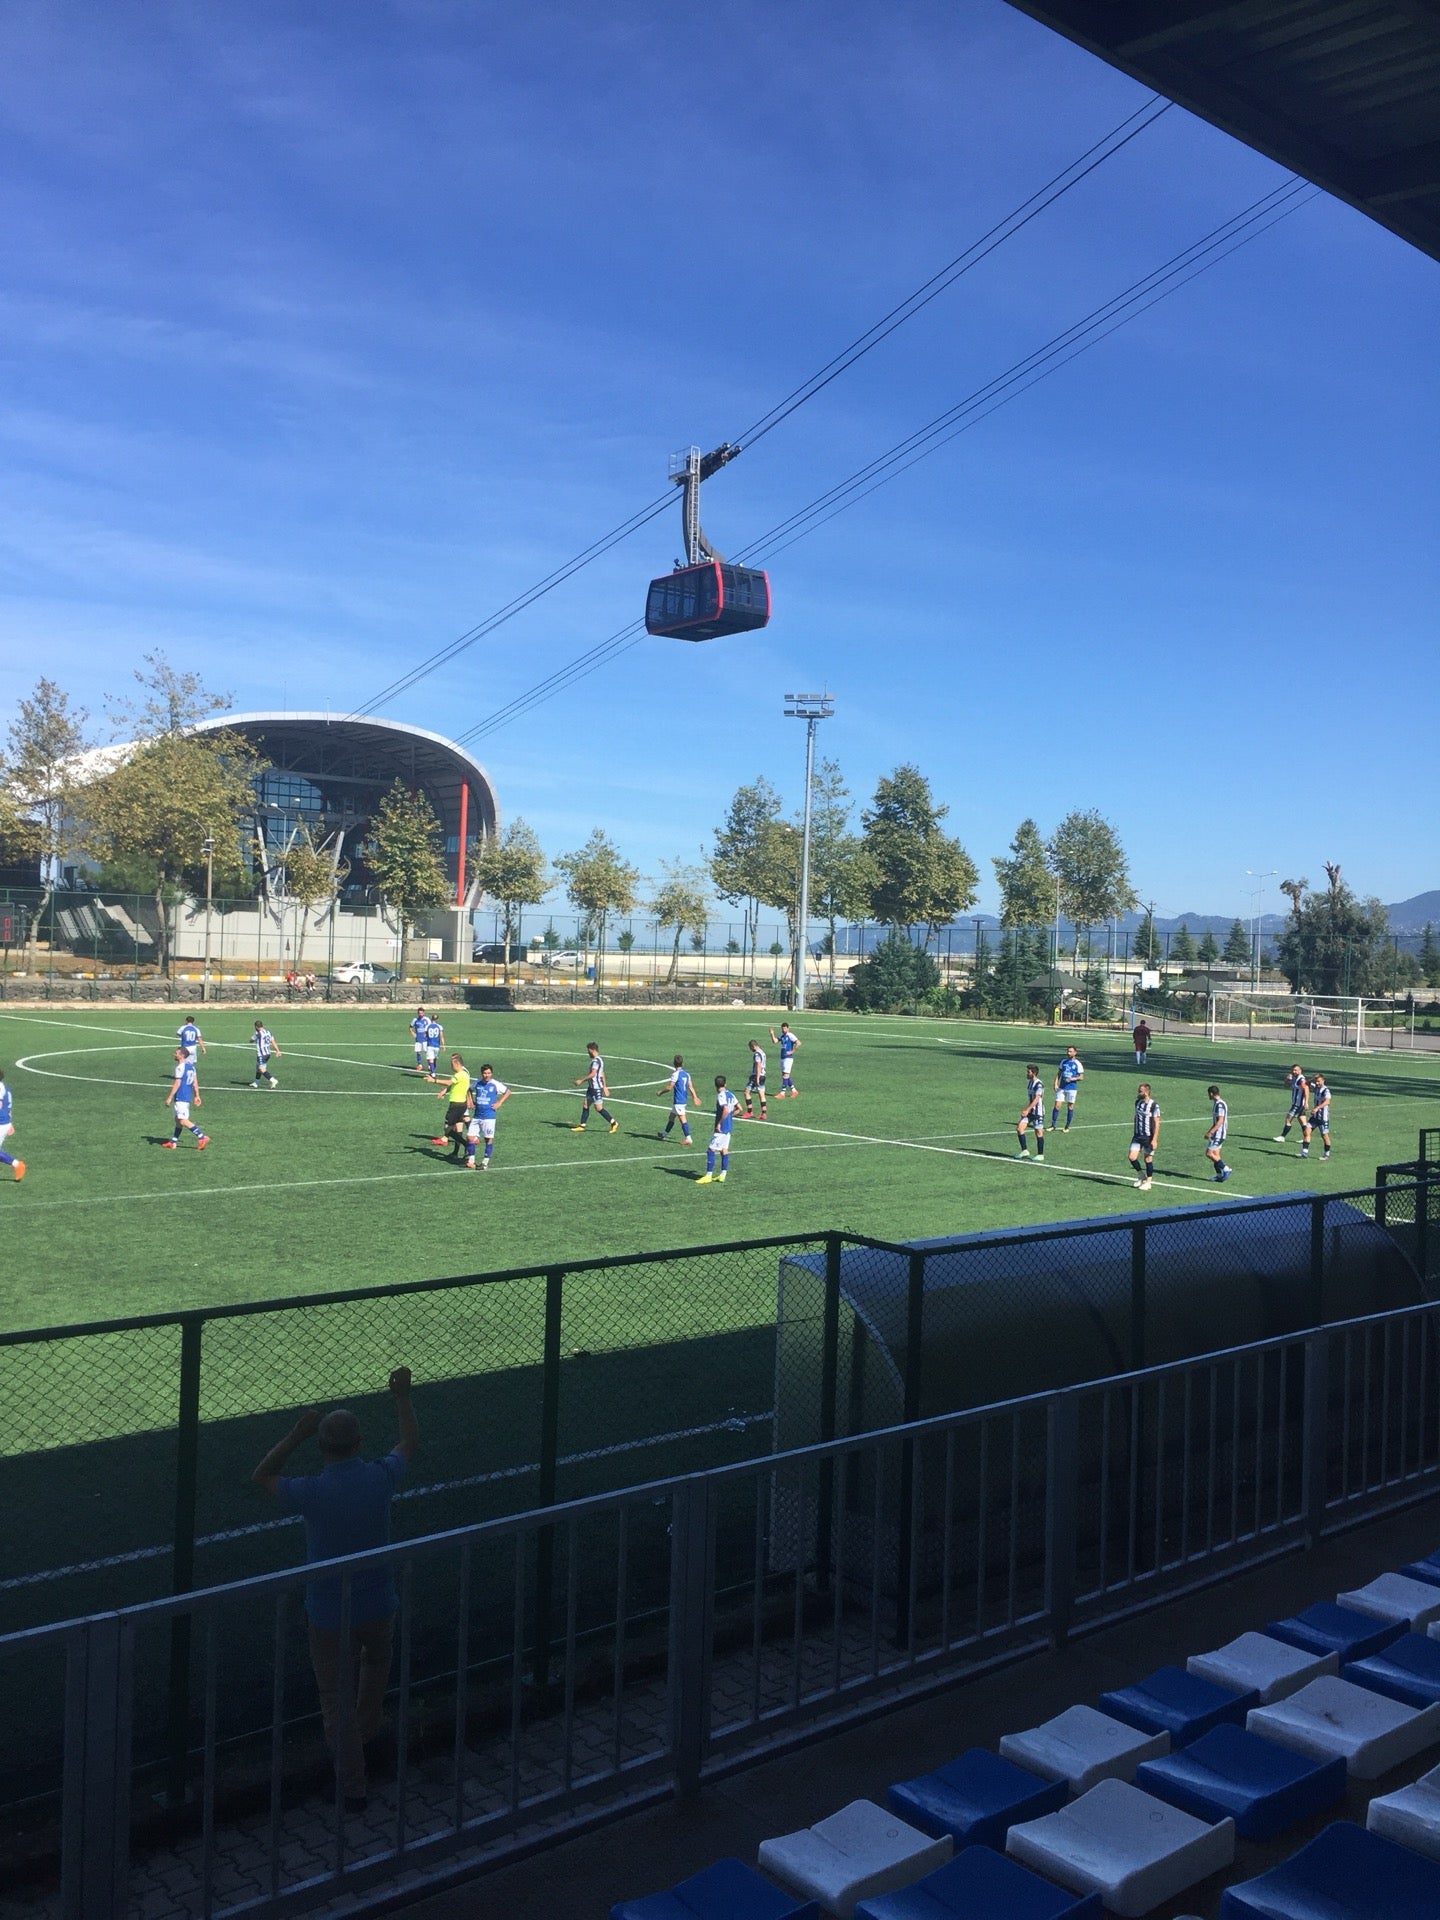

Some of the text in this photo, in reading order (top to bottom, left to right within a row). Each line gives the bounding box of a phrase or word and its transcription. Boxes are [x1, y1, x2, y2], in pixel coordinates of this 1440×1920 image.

[184, 1030, 196, 1042] 10
[428, 1027, 439, 1038] 89
[682, 1077, 688, 1091] 7
